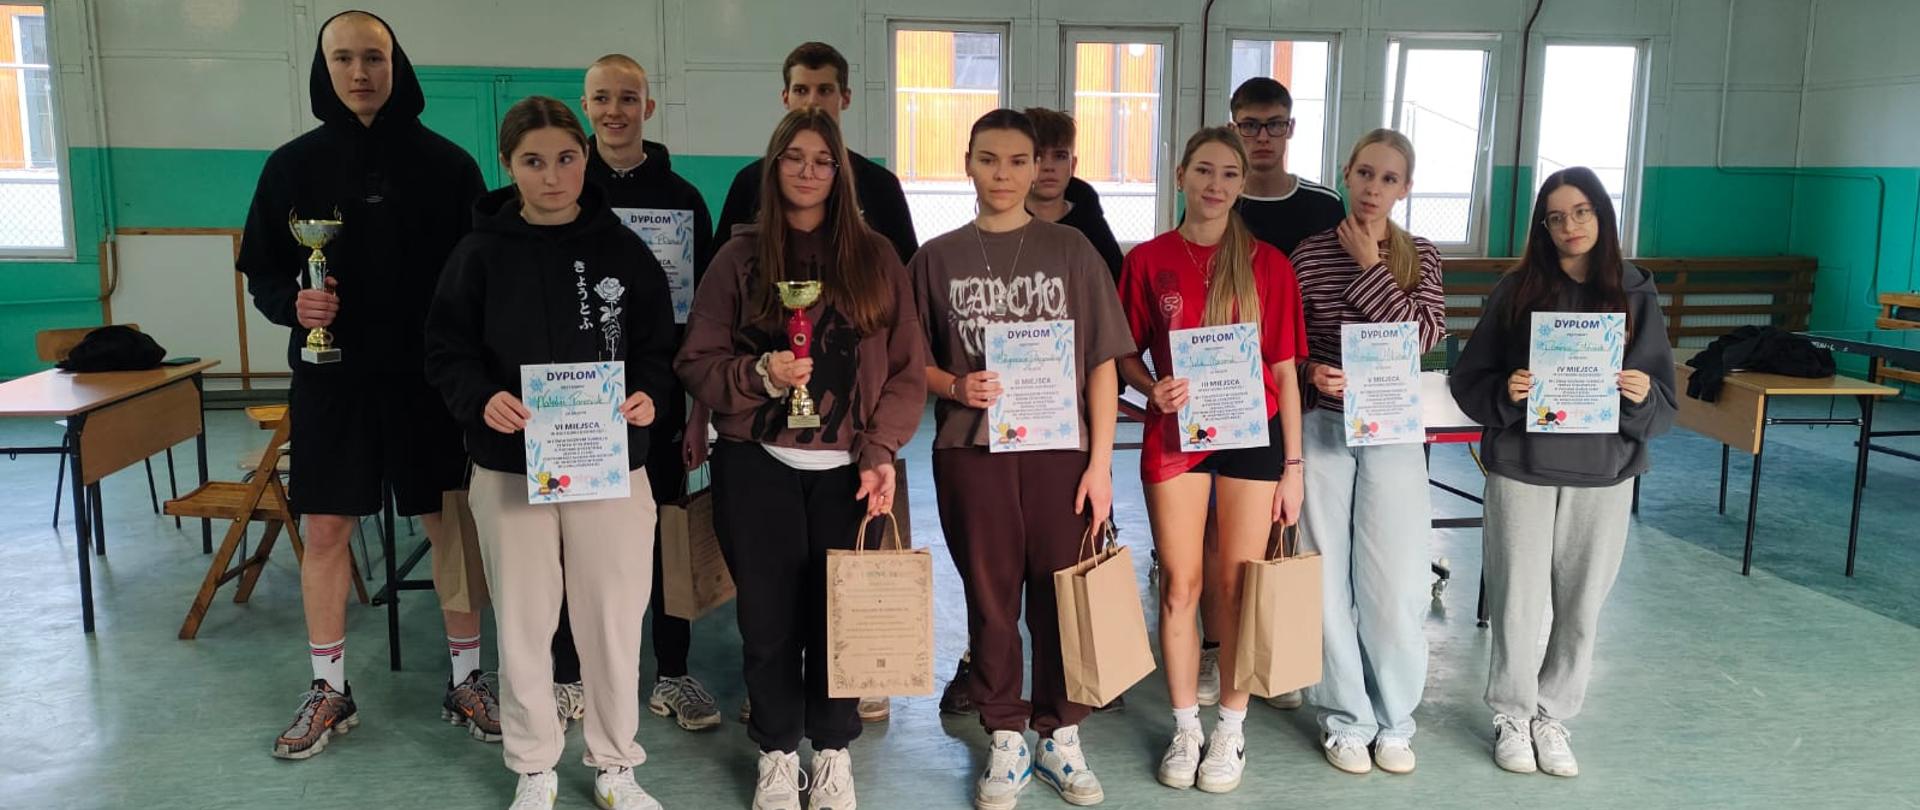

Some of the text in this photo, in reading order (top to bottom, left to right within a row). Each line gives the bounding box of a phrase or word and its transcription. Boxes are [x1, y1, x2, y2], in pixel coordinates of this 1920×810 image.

[630, 214, 672, 225] DYPLOM
[573, 260, 594, 330] きょうとふ
[1554, 319, 1600, 329] DYPLOM
[1007, 328, 1050, 339] DYPLOM
[1191, 332, 1234, 345] DYPLOM
[1360, 329, 1399, 340] DYPLOM
[546, 370, 597, 381] DYPLOM
[564, 421, 601, 431] MIEJSCA
